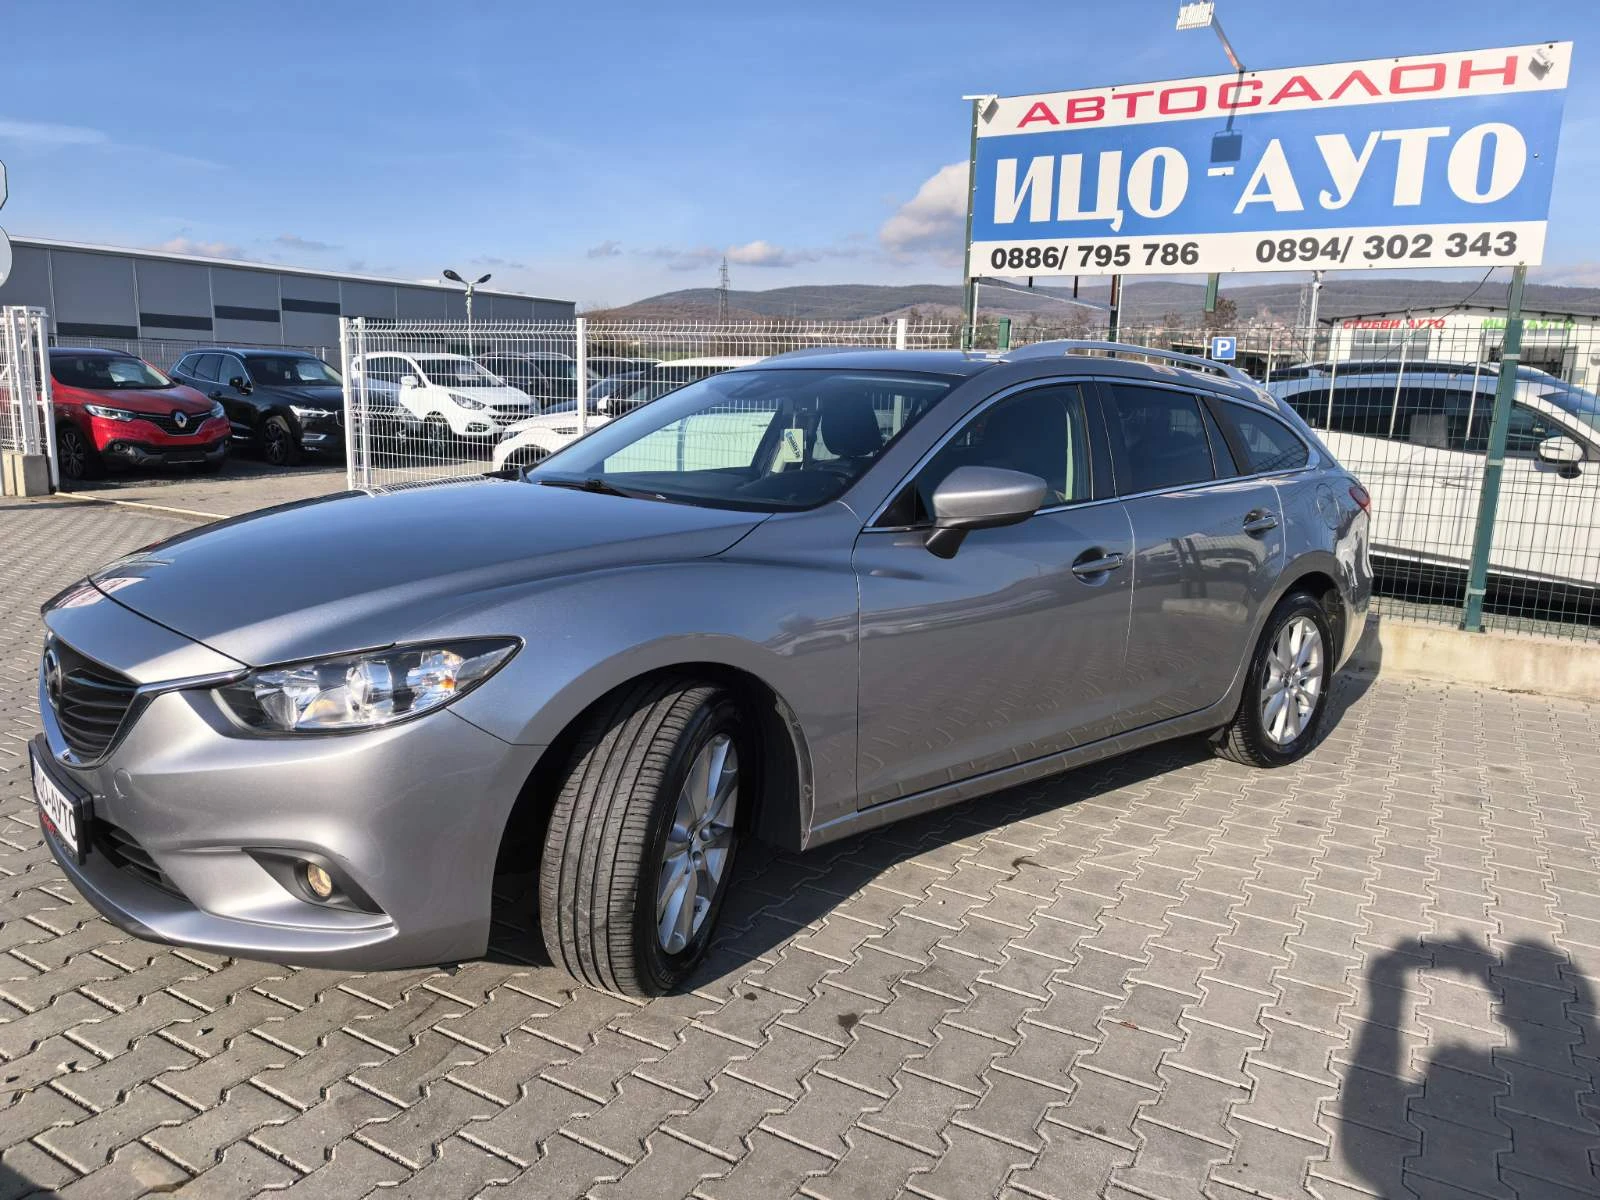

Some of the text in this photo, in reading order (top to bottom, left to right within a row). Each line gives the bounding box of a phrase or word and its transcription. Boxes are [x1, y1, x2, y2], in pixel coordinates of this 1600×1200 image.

[1017, 56, 1518, 128] АВТОСАЛОН
[991, 242, 1200, 270] 0886/ 795 786
[1255, 230, 1518, 263] 0894/ 302 343
[1216, 340, 1231, 357] P
